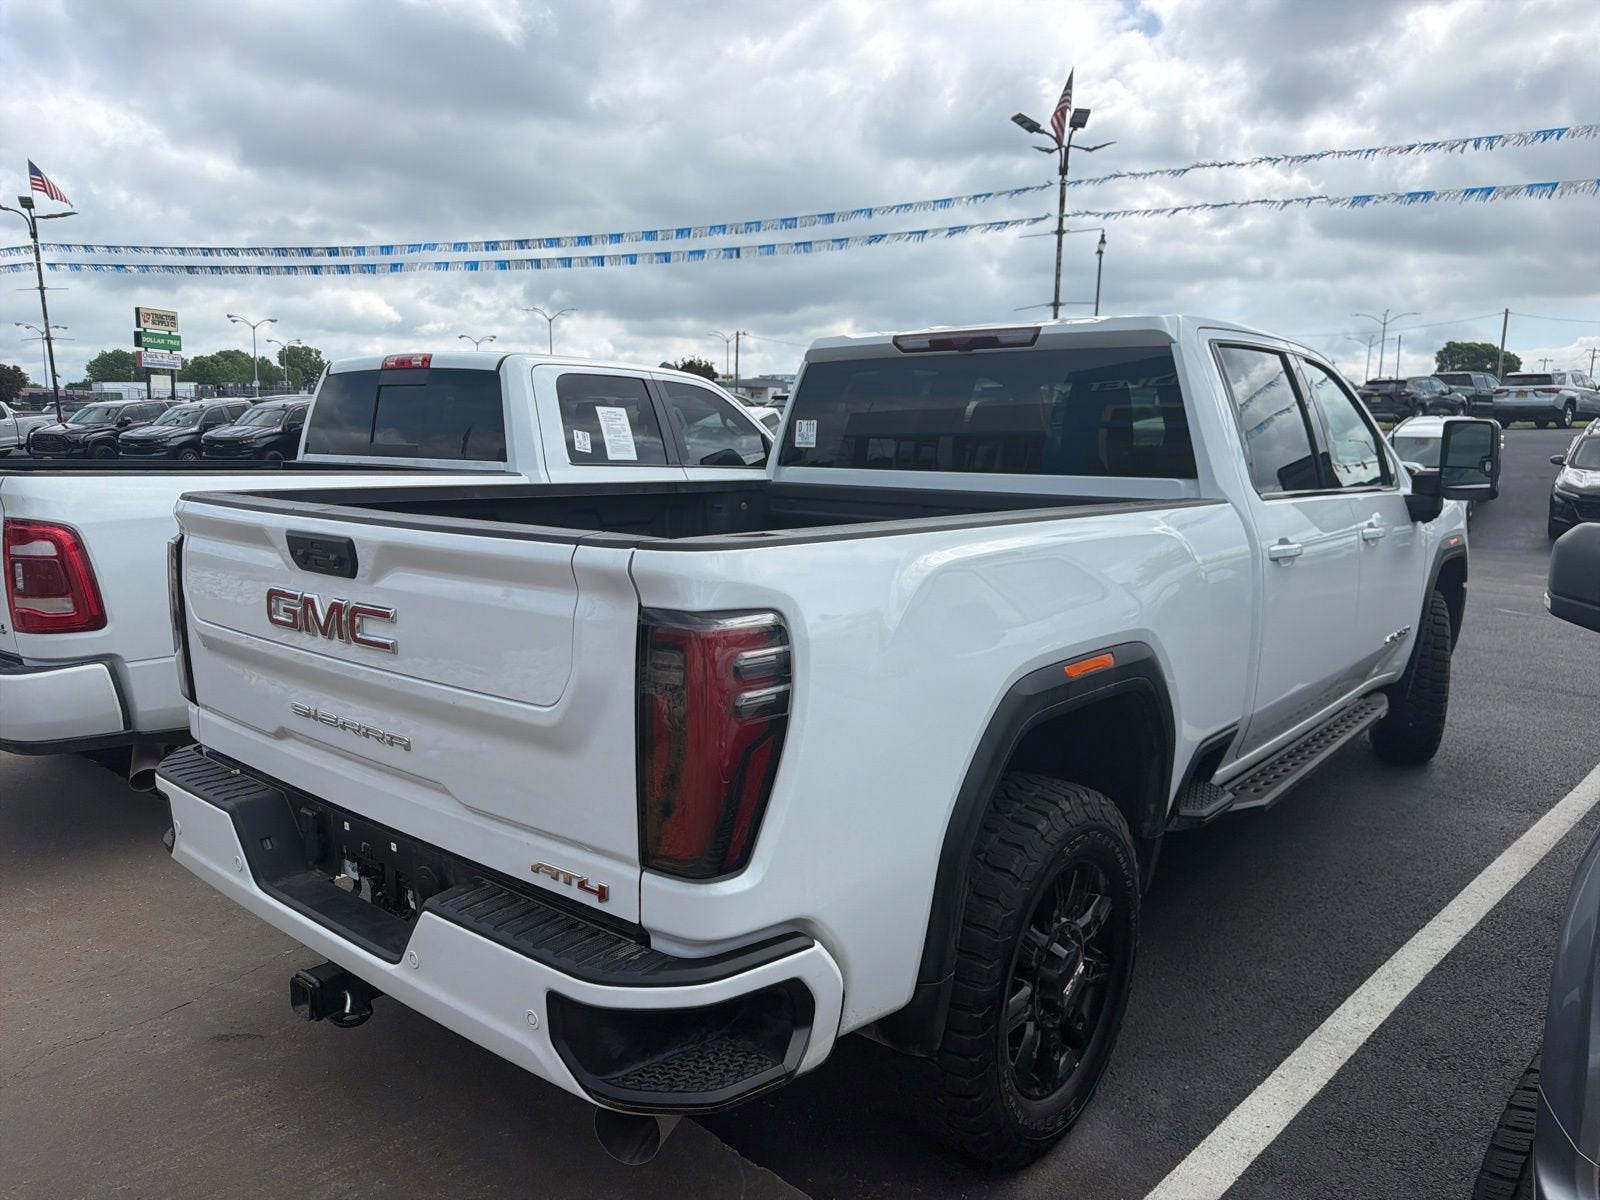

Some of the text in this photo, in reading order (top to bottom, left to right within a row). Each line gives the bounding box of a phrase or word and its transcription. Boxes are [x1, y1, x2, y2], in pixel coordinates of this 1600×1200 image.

[150, 312, 176, 321] TRACTOR
[806, 422, 814, 432] 111
[266, 586, 398, 655] GMC
[291, 701, 411, 752] SIERRA
[531, 861, 609, 903] AT4
